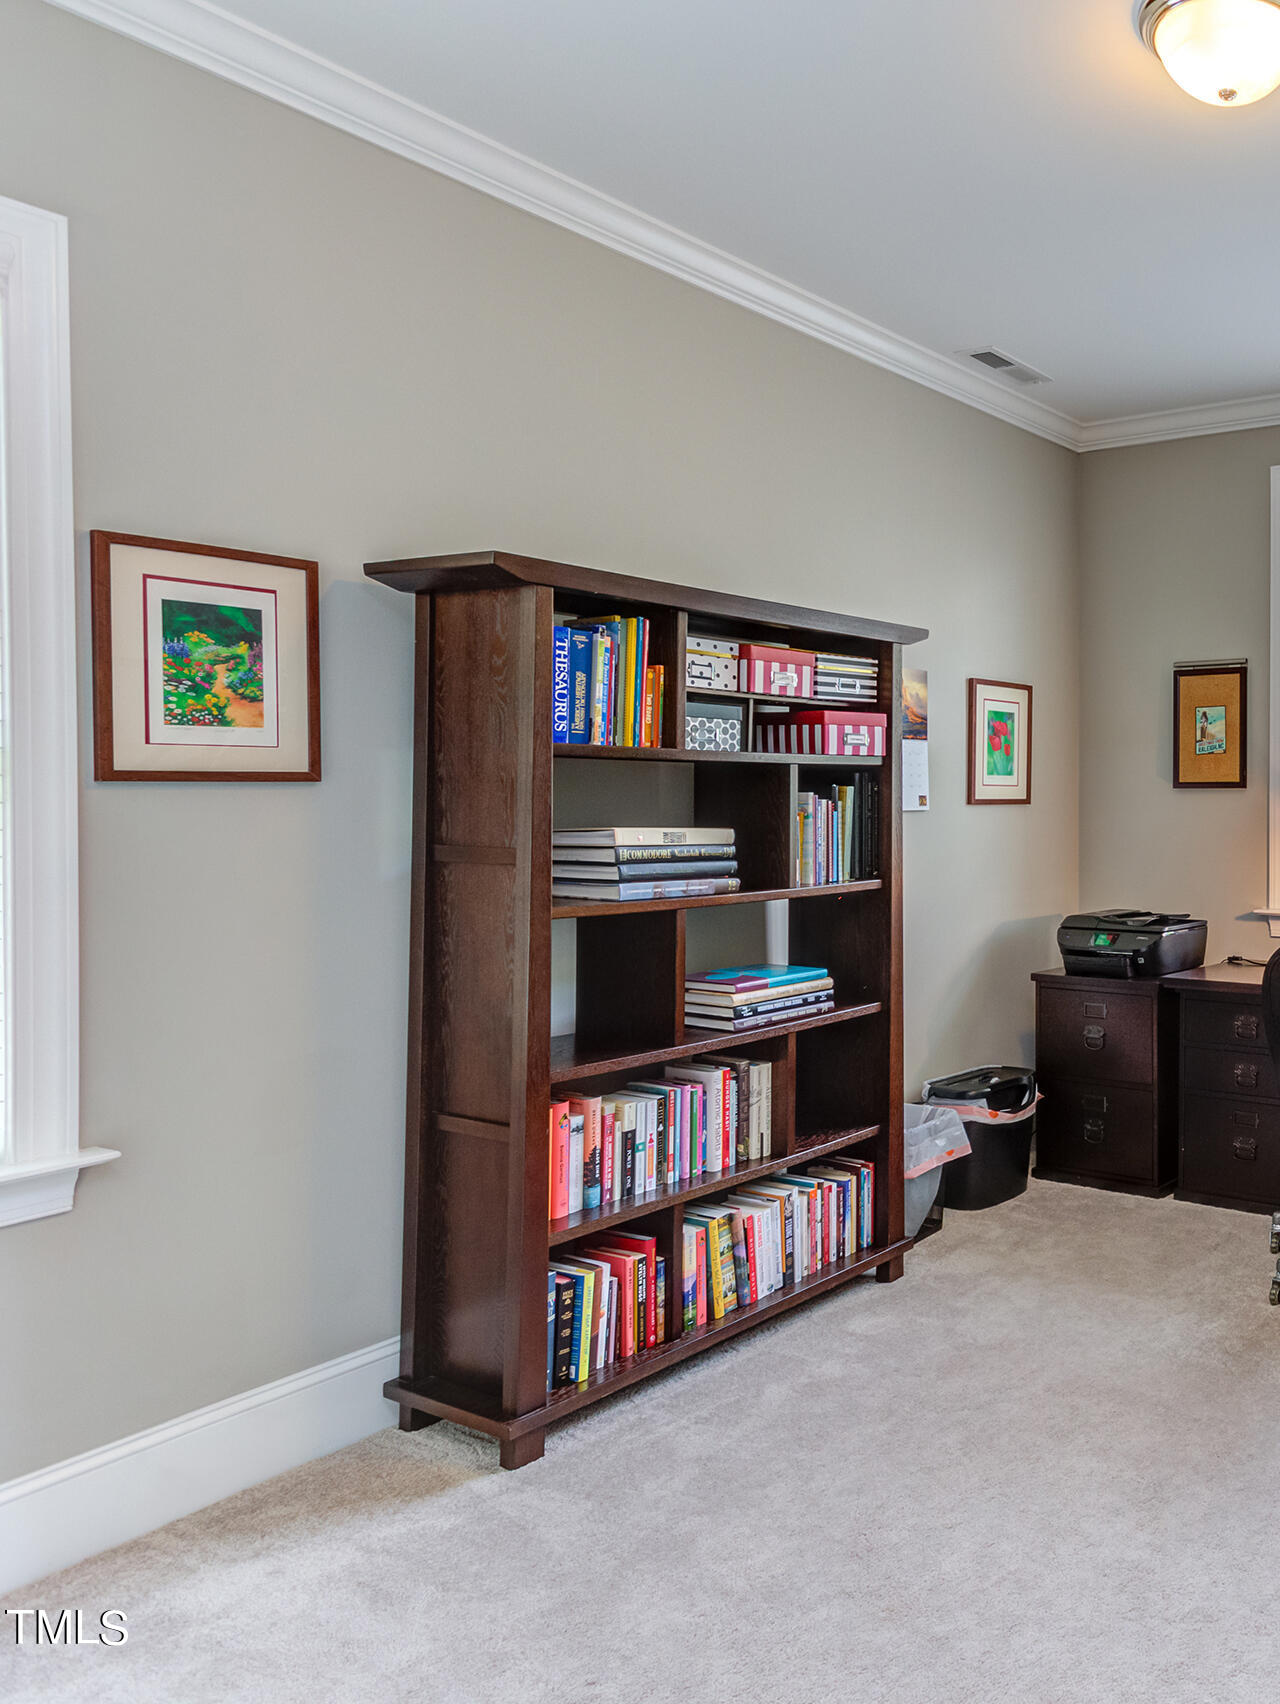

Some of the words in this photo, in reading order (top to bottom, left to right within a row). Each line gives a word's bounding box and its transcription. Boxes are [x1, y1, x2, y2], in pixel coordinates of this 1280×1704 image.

[554, 637, 569, 732] THESAURUS
[627, 848, 672, 860] COMMODORE
[714, 1087, 722, 1121] Atomic
[714, 1122, 722, 1149] Habits
